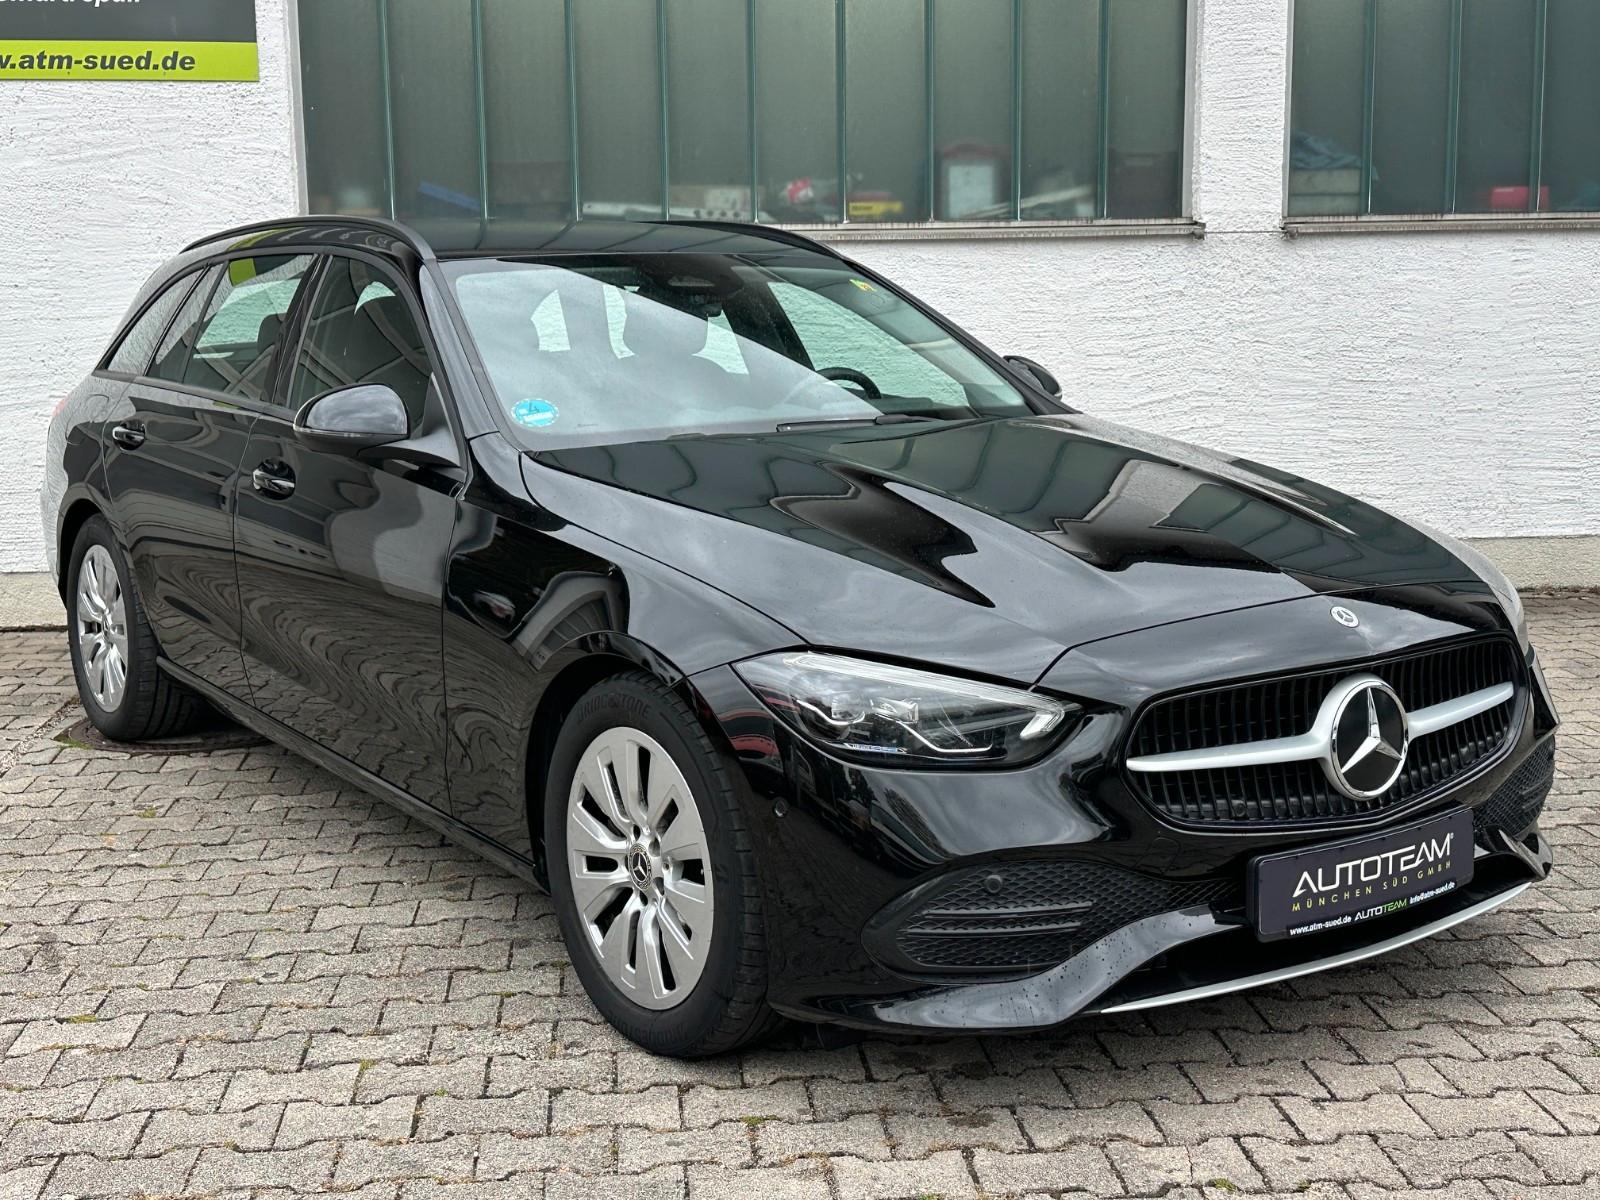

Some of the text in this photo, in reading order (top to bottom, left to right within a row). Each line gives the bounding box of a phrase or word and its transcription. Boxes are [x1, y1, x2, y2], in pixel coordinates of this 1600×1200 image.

[1292, 860, 1452, 912] MÜNCHEN SÜD GMBH
[1289, 914, 1352, 936] www.atm-sued.de
[1354, 898, 1408, 921] AUTOTEAM
